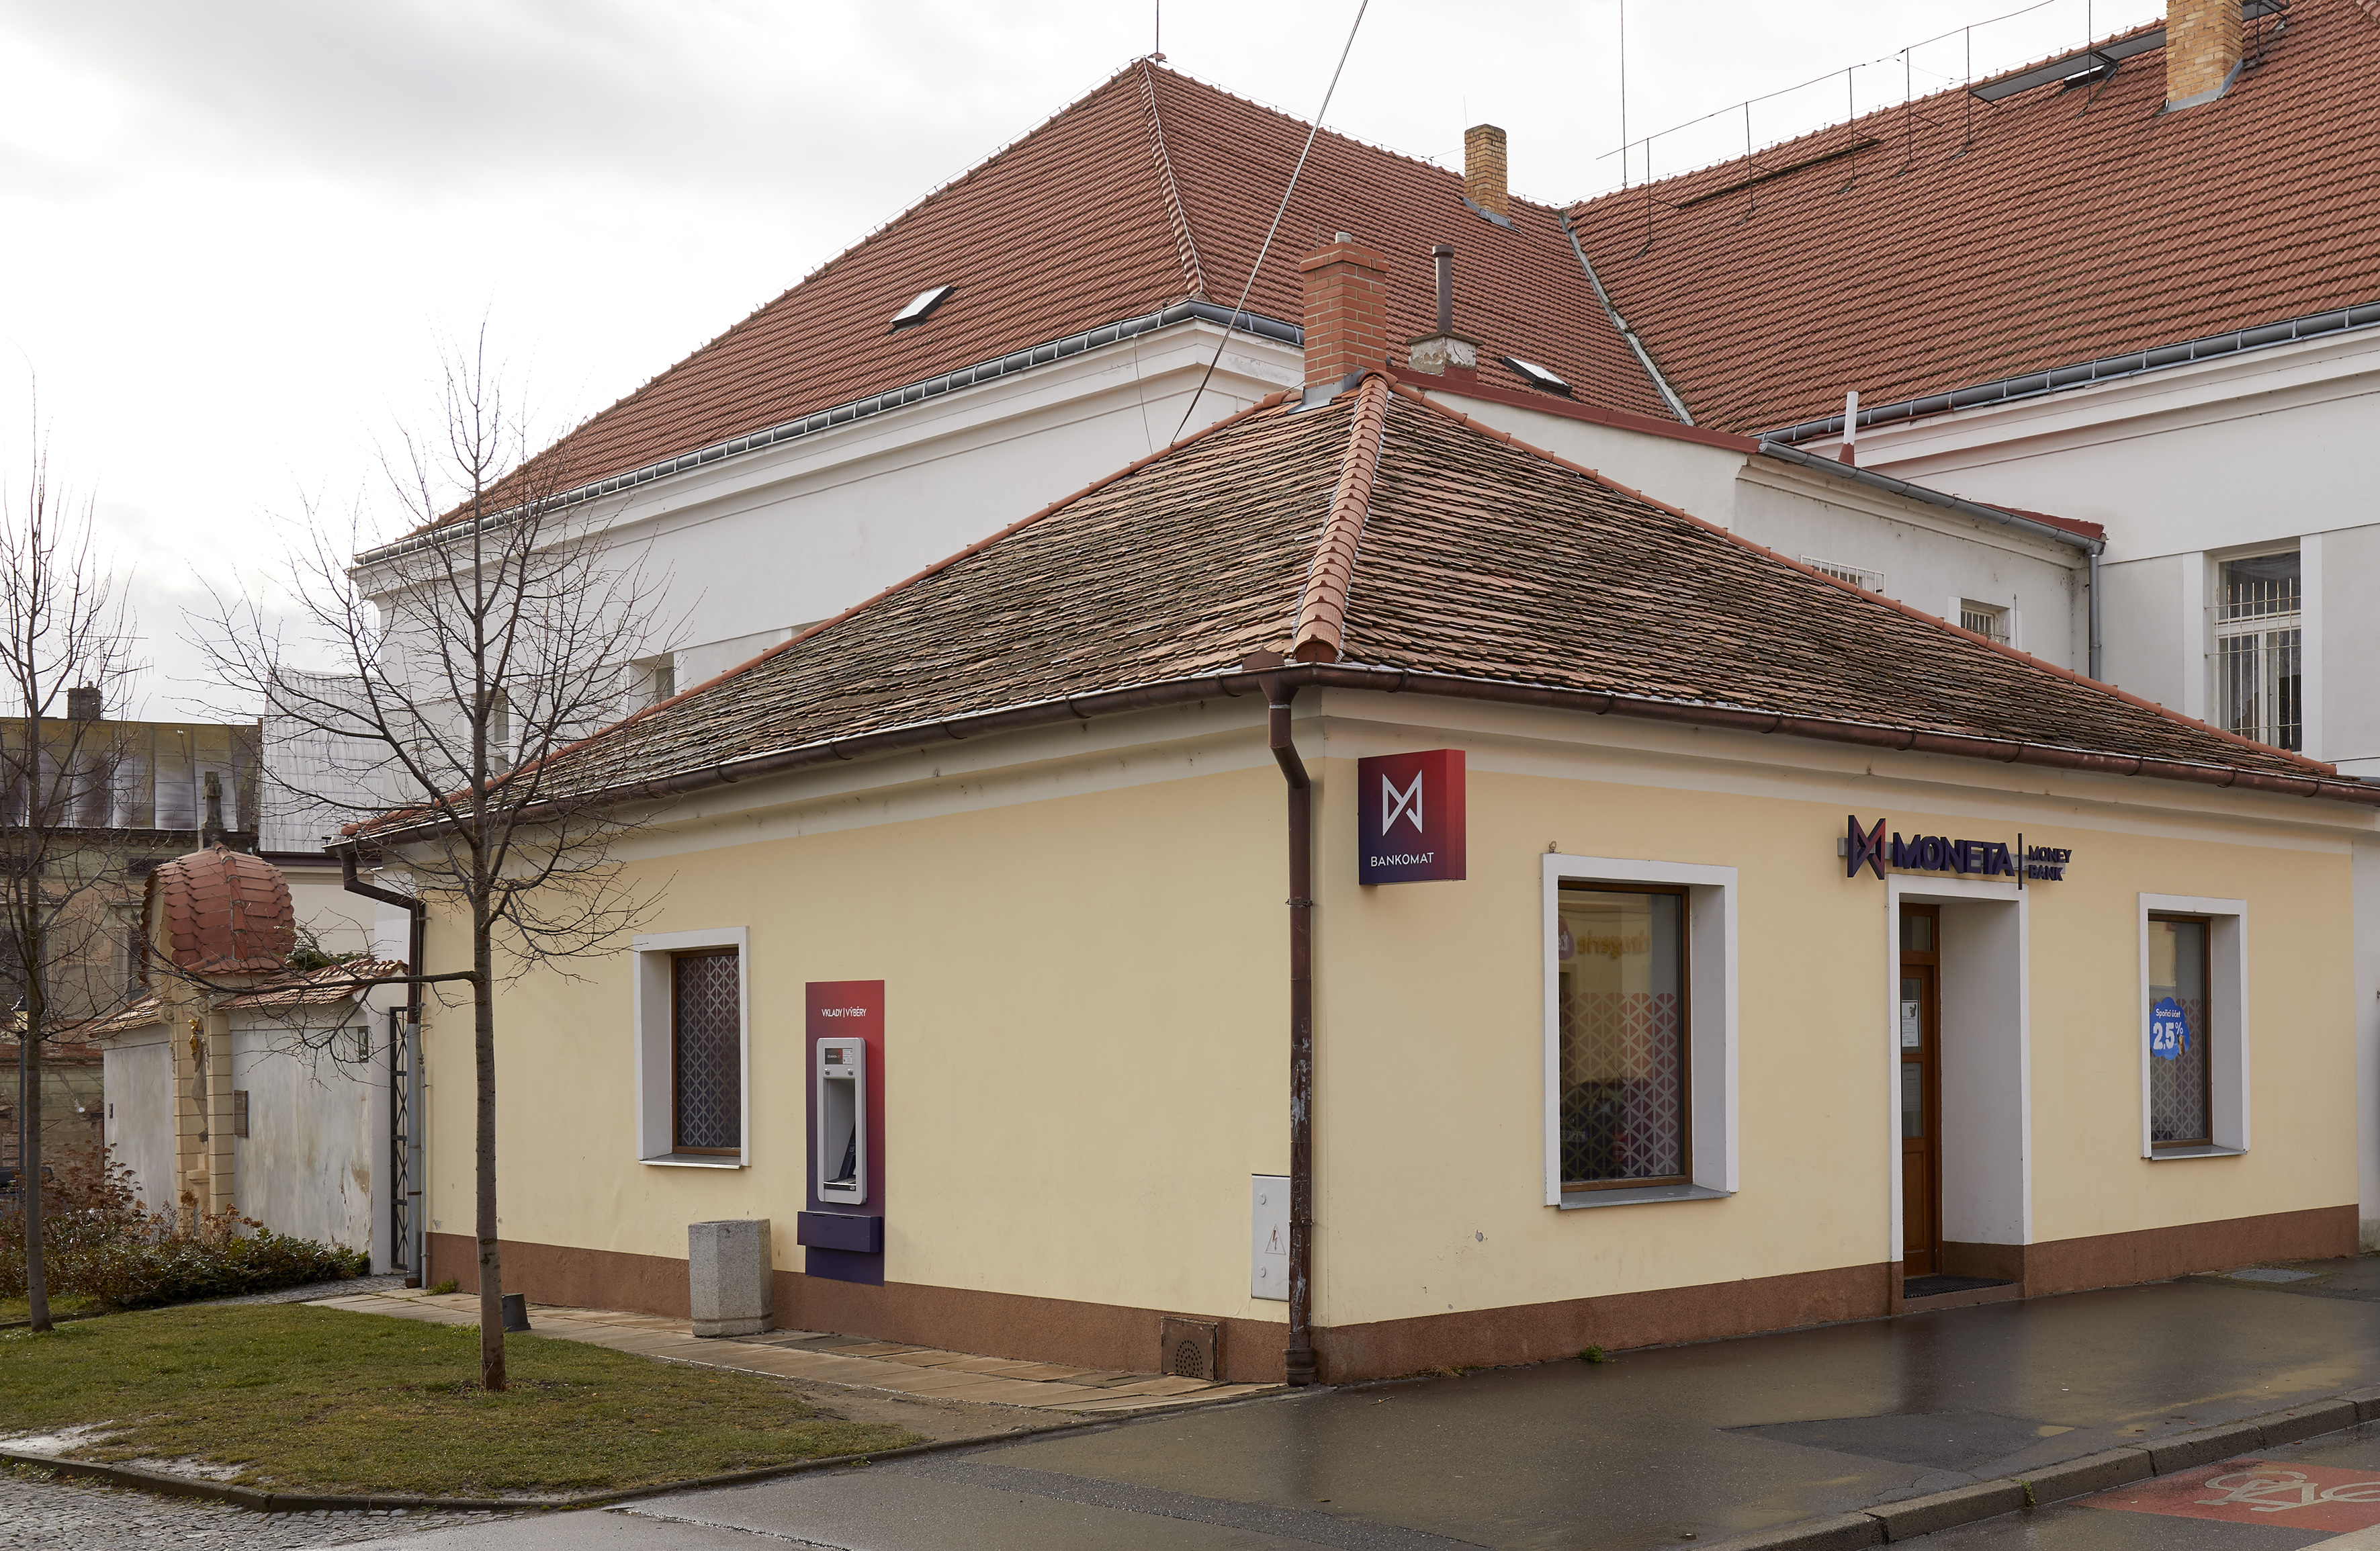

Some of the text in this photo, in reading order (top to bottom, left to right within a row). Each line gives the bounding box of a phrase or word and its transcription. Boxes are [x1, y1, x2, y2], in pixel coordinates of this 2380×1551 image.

[1370, 852, 1434, 867] BANKOMAT
[1893, 832, 2015, 877] MONETA
[2029, 845, 2072, 863] MONEY
[2029, 865, 2063, 881] BANK
[822, 1009, 842, 1017] VKLADY
[2171, 1010, 2181, 1018] účet
